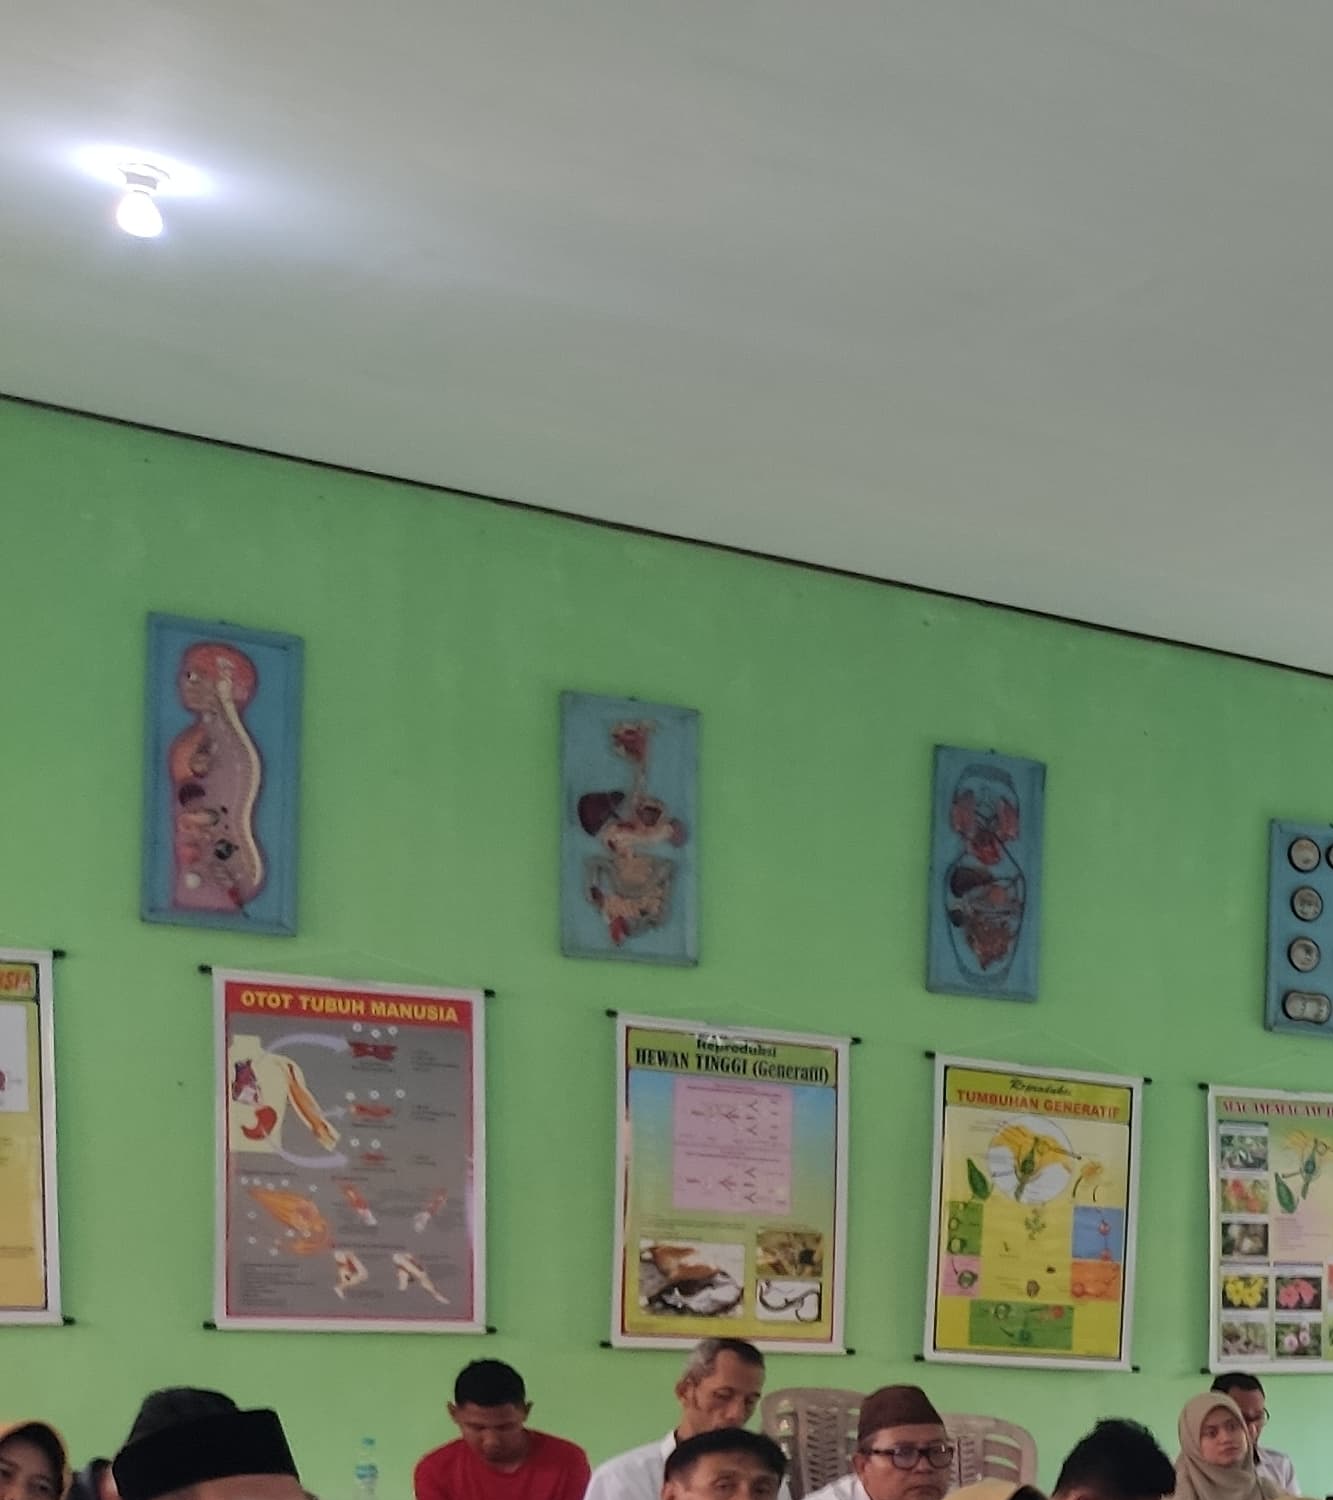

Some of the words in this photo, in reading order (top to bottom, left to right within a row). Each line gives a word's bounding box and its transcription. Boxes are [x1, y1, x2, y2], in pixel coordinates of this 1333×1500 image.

[240, 990, 293, 1009] OTOT
[300, 995, 365, 1015] TUBUH
[371, 1001, 458, 1023] MANUSIA
[635, 1048, 689, 1069] HEWAN
[696, 1053, 748, 1075] TINGGI
[753, 1059, 829, 1084] (Generatif)
[956, 1089, 1040, 1109] TUMBUHAN
[1044, 1099, 1122, 1119] GENERATIF
